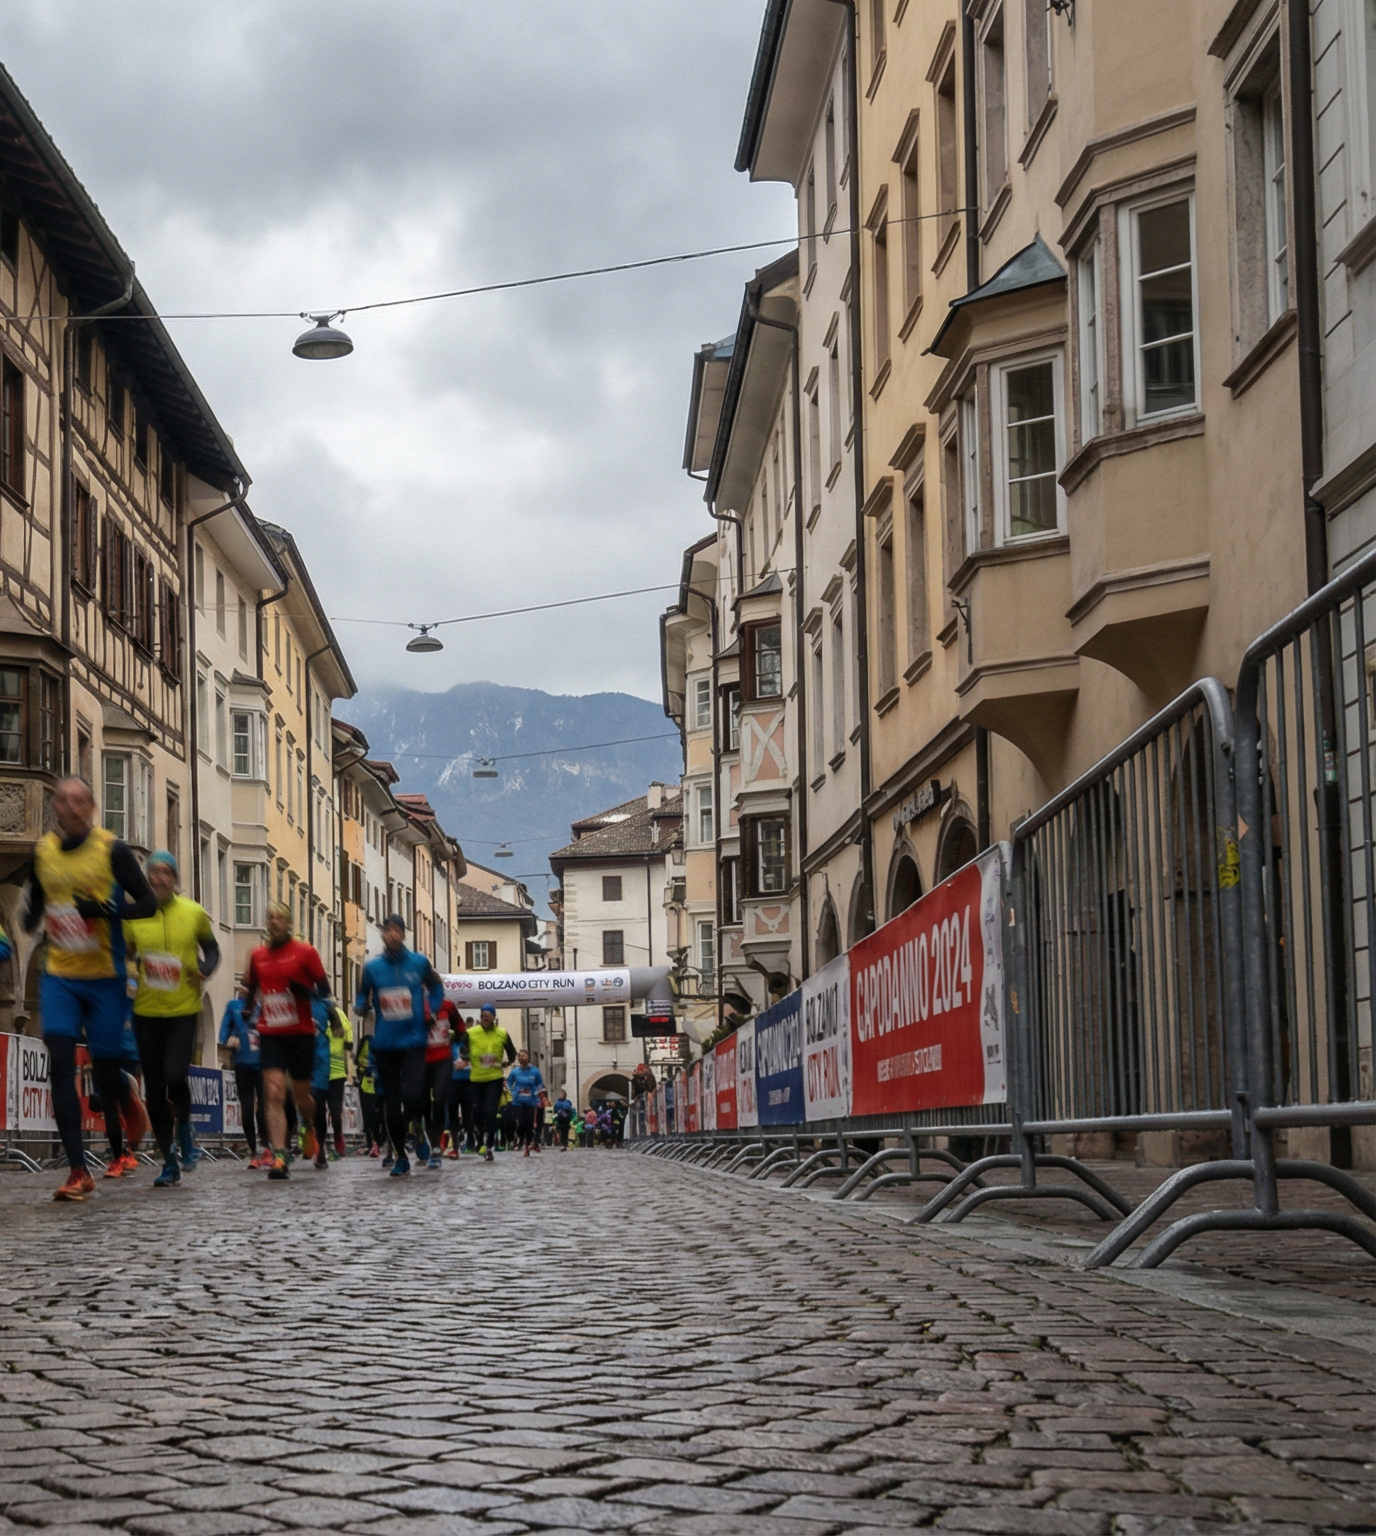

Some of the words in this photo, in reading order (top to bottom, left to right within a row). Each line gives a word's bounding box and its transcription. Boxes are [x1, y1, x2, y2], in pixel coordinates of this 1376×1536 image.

[478, 980, 526, 990] BOLZANO
[553, 977, 575, 988] RUN
[856, 932, 929, 1042] CAPODANNO
[931, 905, 972, 1016] 2024
[23, 1086, 43, 1119] CITY
